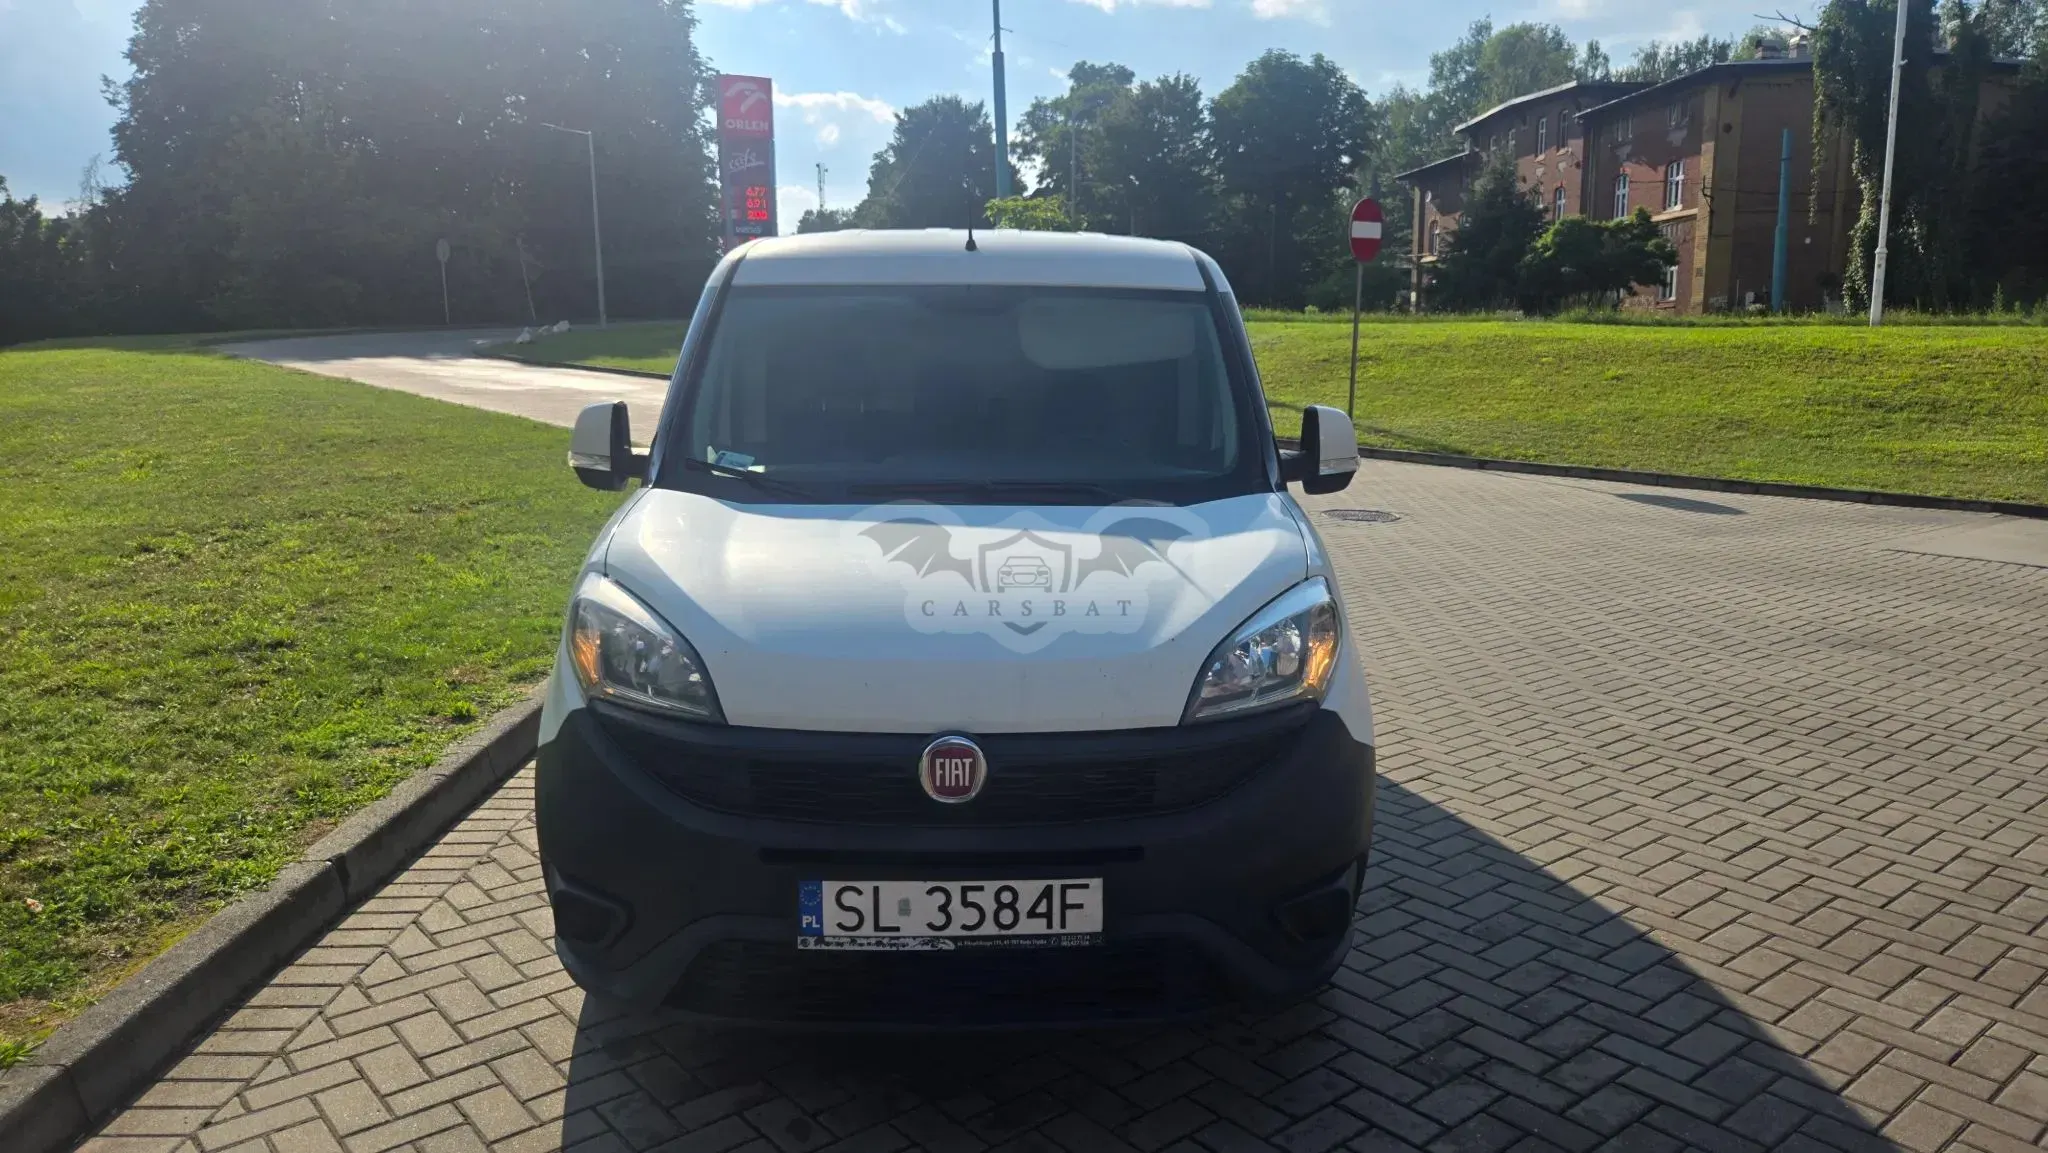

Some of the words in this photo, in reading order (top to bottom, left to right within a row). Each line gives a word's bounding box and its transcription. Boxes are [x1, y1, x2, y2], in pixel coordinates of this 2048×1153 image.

[725, 119, 769, 130] ORLEN
[935, 758, 973, 787] FIAT
[834, 885, 901, 933] SL
[925, 883, 1091, 932] 3584F
[802, 915, 820, 928] PL
